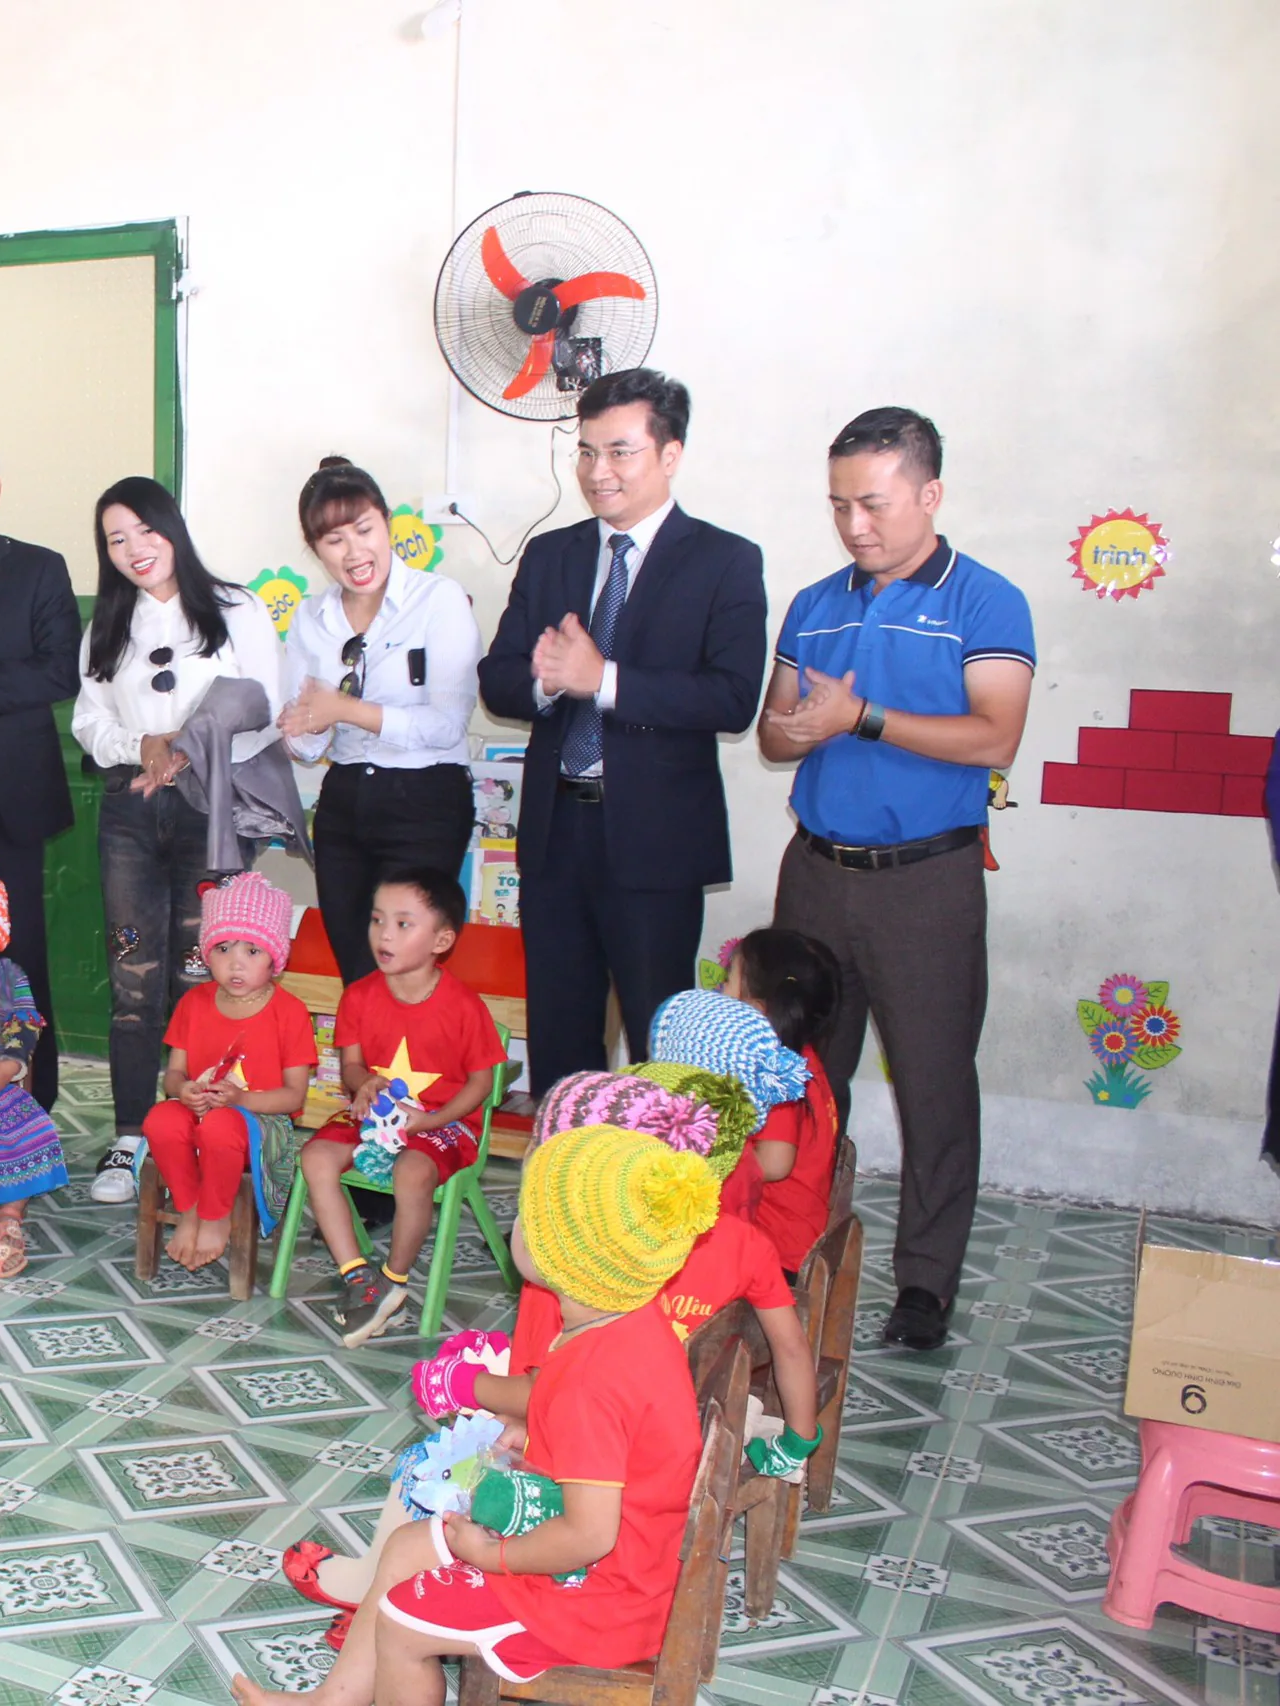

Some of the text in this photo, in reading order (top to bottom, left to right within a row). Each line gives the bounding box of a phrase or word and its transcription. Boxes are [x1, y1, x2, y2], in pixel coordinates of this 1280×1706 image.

[391, 529, 429, 561] ách
[1093, 544, 1147, 566] trình
[671, 1294, 713, 1320] Yêu
